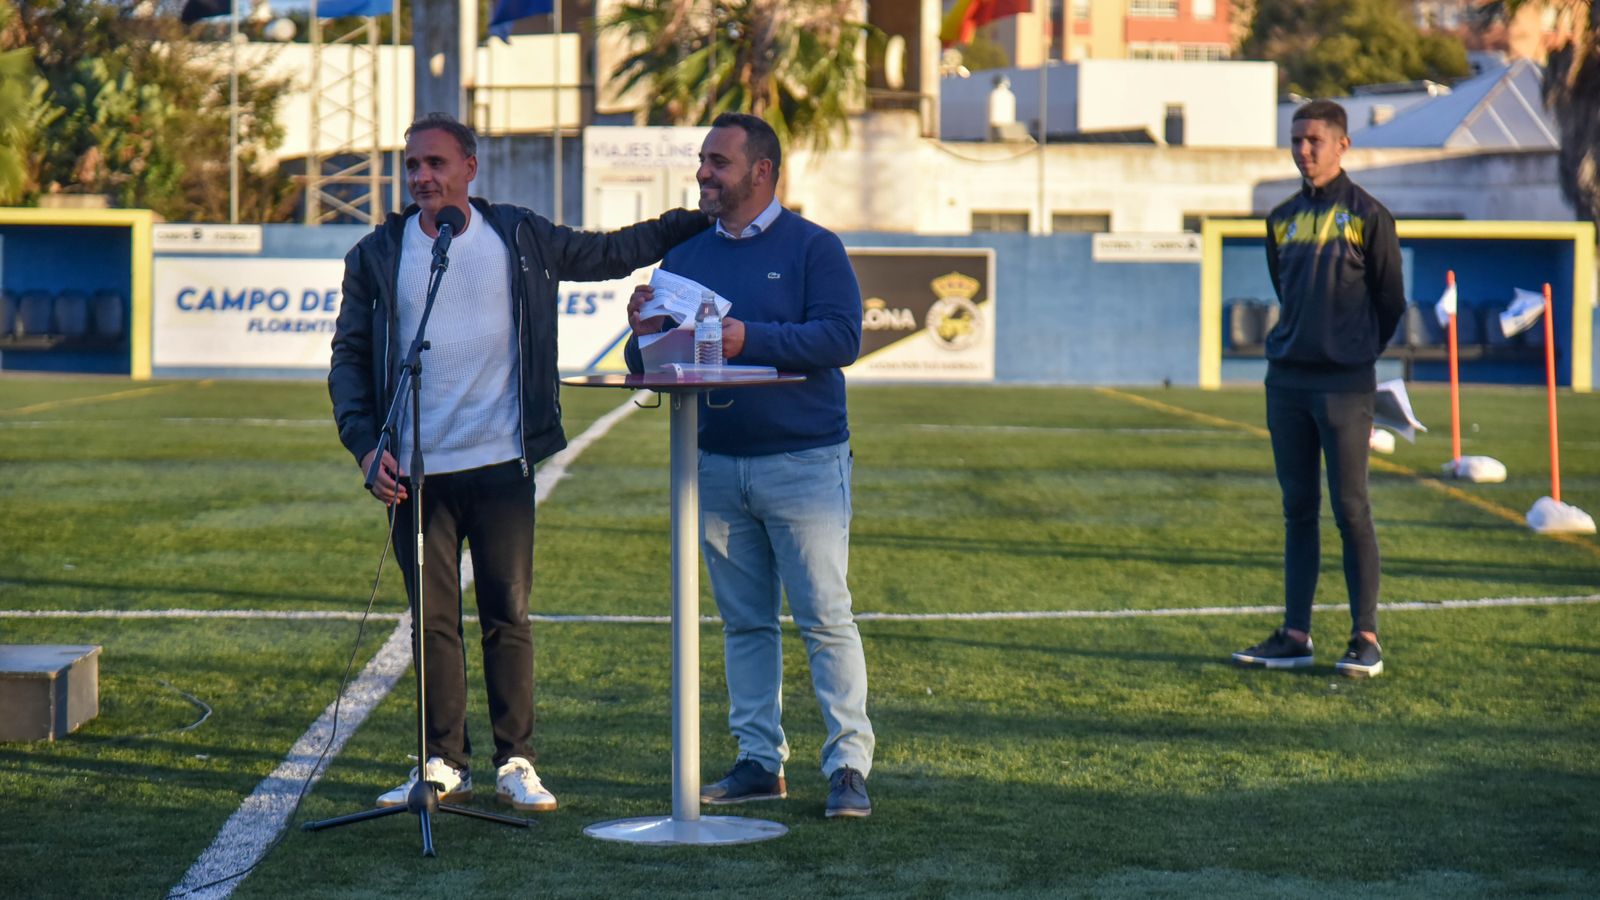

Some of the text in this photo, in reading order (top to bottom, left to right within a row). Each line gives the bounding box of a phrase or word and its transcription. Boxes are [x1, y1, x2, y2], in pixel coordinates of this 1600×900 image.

[592, 142, 700, 157] VIAJES LINE
[176, 287, 290, 313] CAMPO
[300, 287, 340, 313] DE
